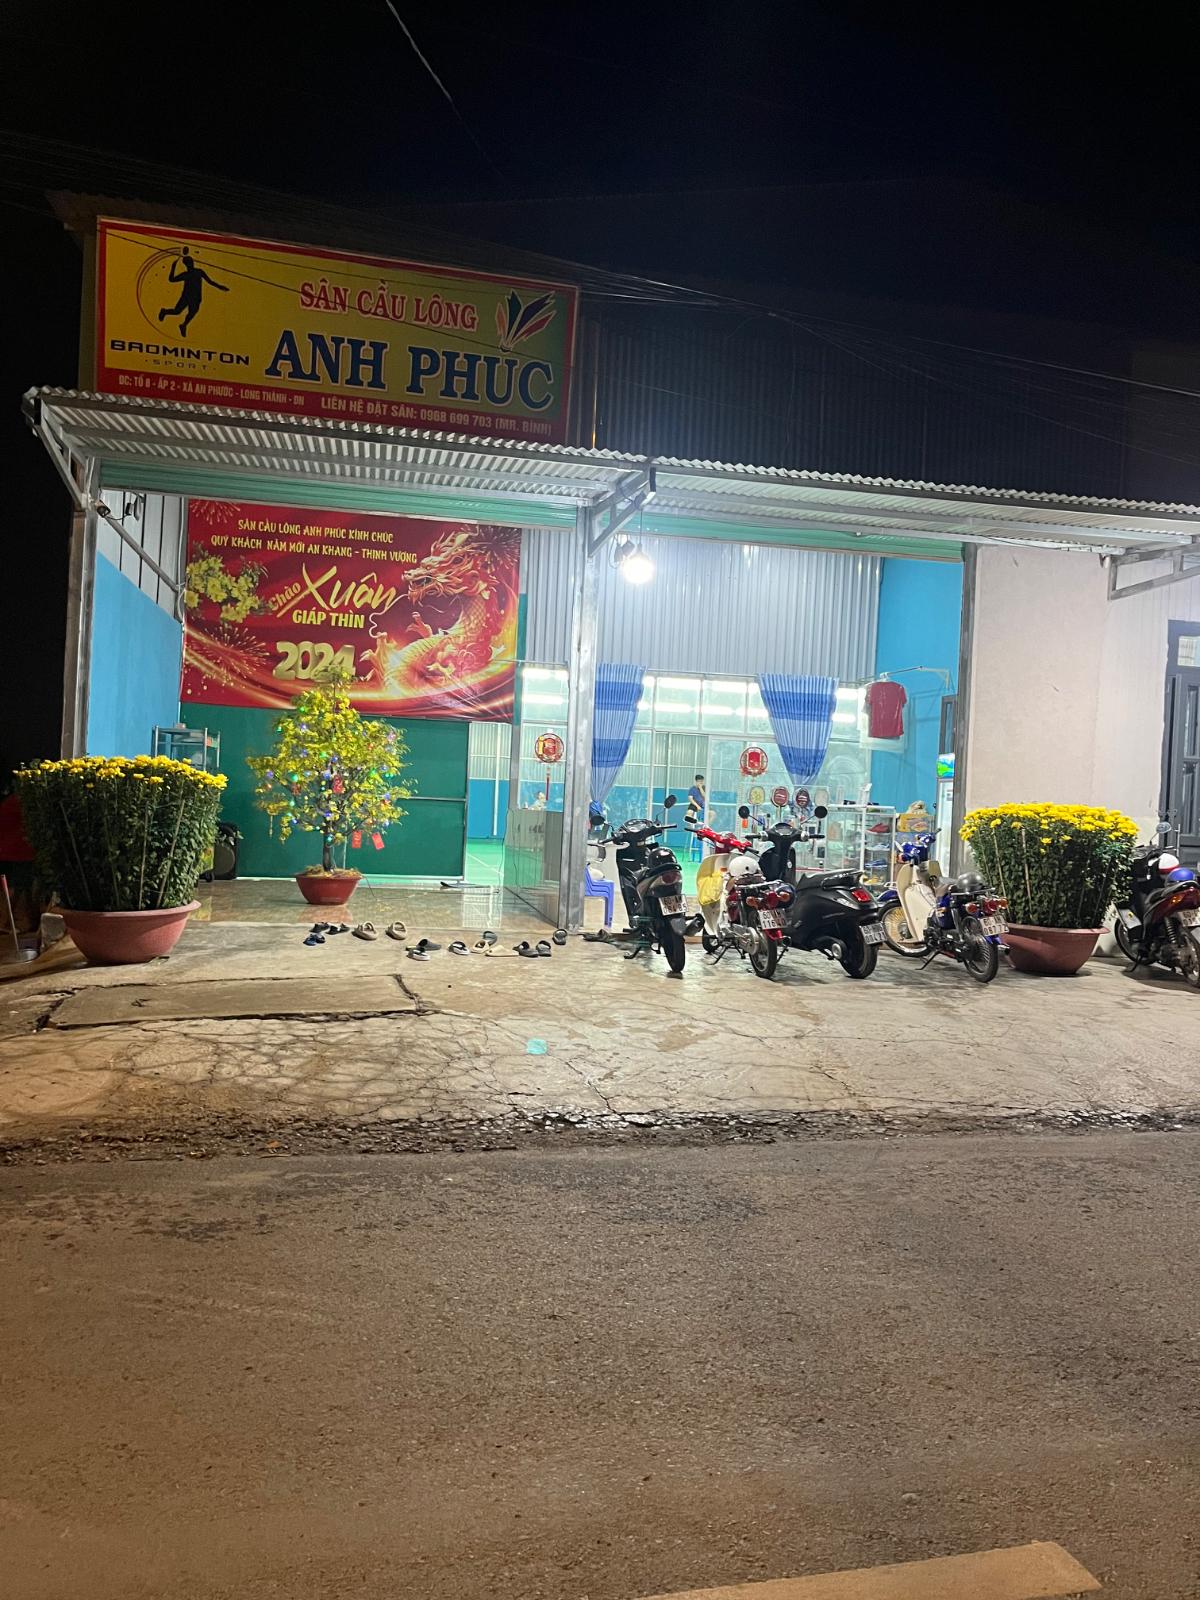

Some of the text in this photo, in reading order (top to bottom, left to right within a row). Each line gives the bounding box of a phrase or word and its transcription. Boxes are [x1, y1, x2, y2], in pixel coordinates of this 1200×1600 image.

[300, 278, 478, 331] SÂN CẦU LÔNG
[110, 339, 250, 366] BADMINTON
[152, 359, 208, 370] SPORT
[264, 329, 389, 391] ANH
[194, 384, 206, 394] AN
[240, 391, 261, 401] LONG
[231, 535, 263, 550] KHÁCH
[307, 544, 321, 555] AN
[322, 544, 353, 558] KHANG
[303, 526, 322, 538] ANH
[349, 527, 370, 542] KÍNH
[277, 562, 397, 618] Xuân
[292, 607, 365, 629] GIÁP THÌN
[272, 641, 356, 683] 2024
